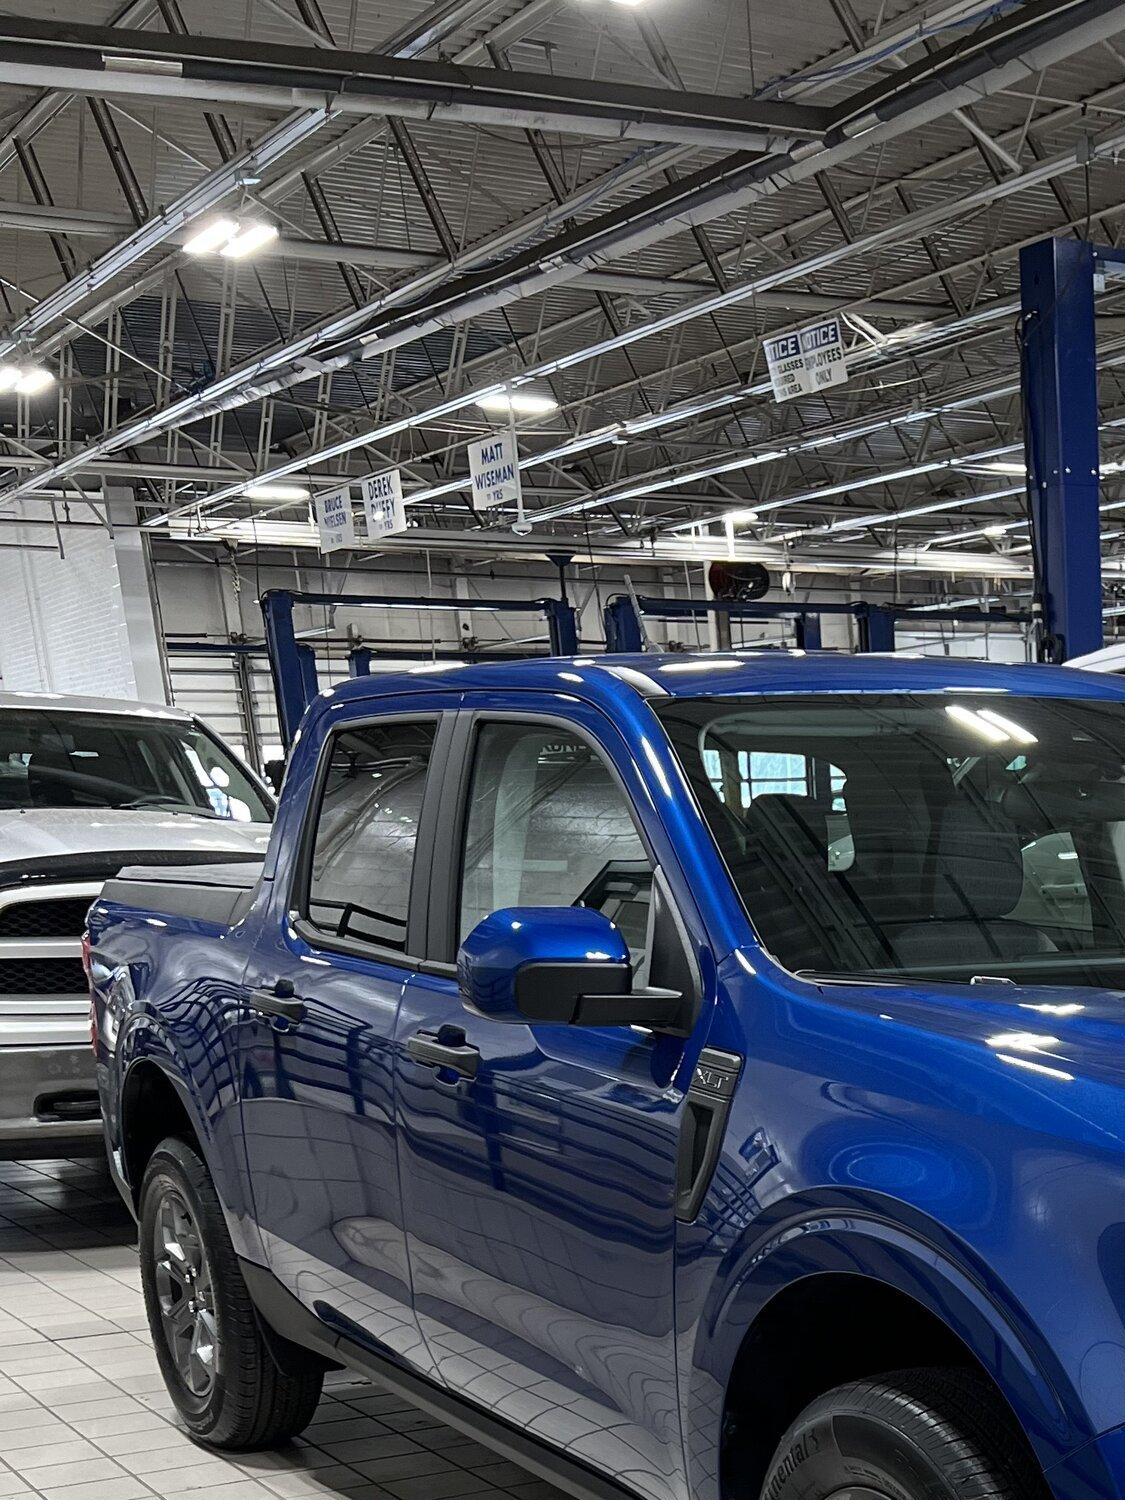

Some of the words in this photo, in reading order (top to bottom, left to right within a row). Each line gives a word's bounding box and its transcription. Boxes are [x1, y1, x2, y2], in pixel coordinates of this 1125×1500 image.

[767, 337, 797, 359] TICE
[481, 442, 503, 466] MATT
[368, 475, 393, 501] DEREK
[474, 463, 515, 490] WISEMAN
[324, 495, 343, 513] BRUCE
[693, 1067, 730, 1089] XLT
